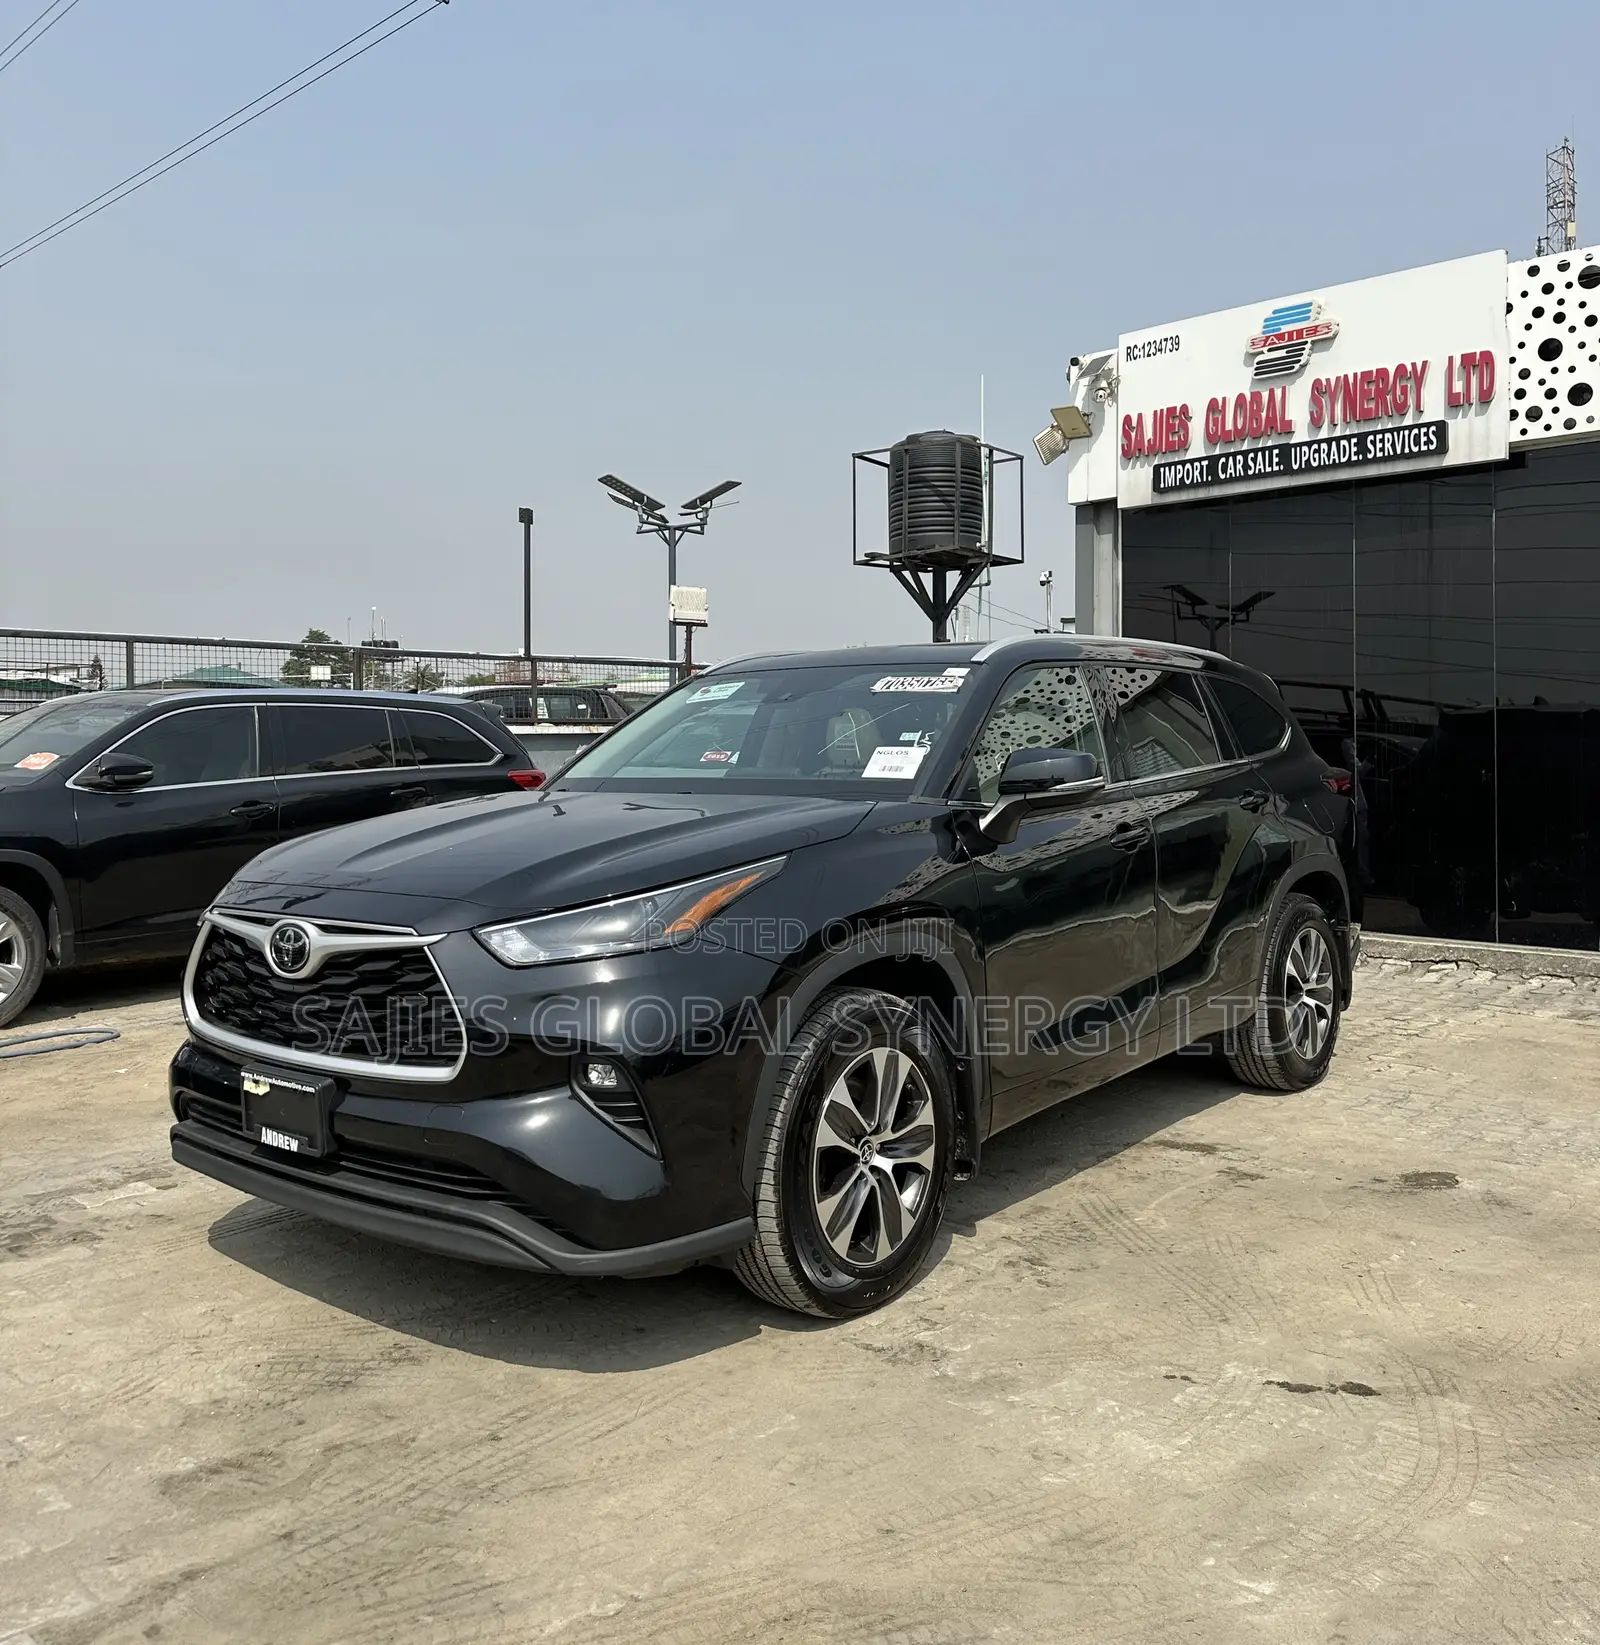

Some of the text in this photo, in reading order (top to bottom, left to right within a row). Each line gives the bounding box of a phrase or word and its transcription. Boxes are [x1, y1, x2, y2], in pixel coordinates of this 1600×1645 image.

[1126, 334, 1180, 362] RC:1234739
[1249, 321, 1333, 349] SAJIES
[1121, 350, 1496, 460] SAJIES GLOBAL SYNERGY LTD
[1159, 425, 1437, 488] IMPORT. CAR SALE. UPGRADE. SERVICES
[261, 1126, 299, 1152] ANDREW
